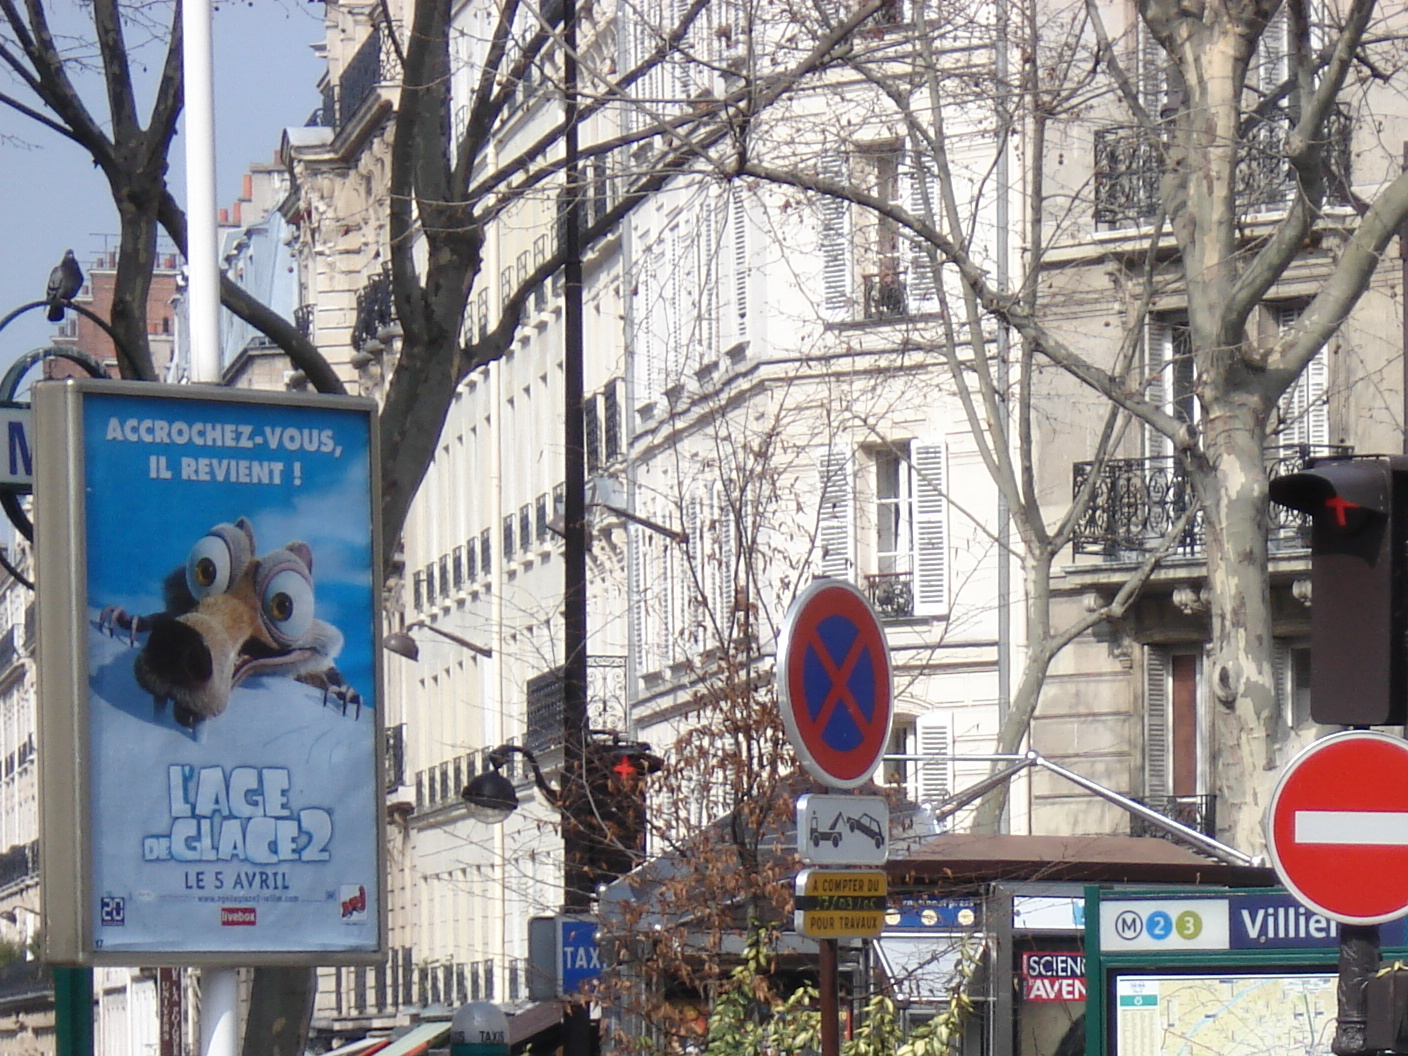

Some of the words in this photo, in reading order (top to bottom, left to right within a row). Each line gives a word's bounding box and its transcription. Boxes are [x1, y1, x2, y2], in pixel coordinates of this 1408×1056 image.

[106, 417, 342, 457] ACCROCHEZ-VOUS,
[149, 456, 172, 479] IL
[181, 457, 284, 485] REVIENT
[293, 461, 302, 486] !
[171, 817, 300, 864] GLACE
[300, 807, 333, 862] 2
[185, 872, 205, 889] LE
[215, 872, 224, 889] 5
[233, 872, 290, 889] AVRIL
[822, 879, 864, 892] COMPTER
[867, 879, 880, 892] DU
[810, 917, 835, 930] POUR
[839, 916, 879, 930] TRAVAUX
[1154, 917, 1165, 933] 2
[1184, 917, 1195, 933] 3
